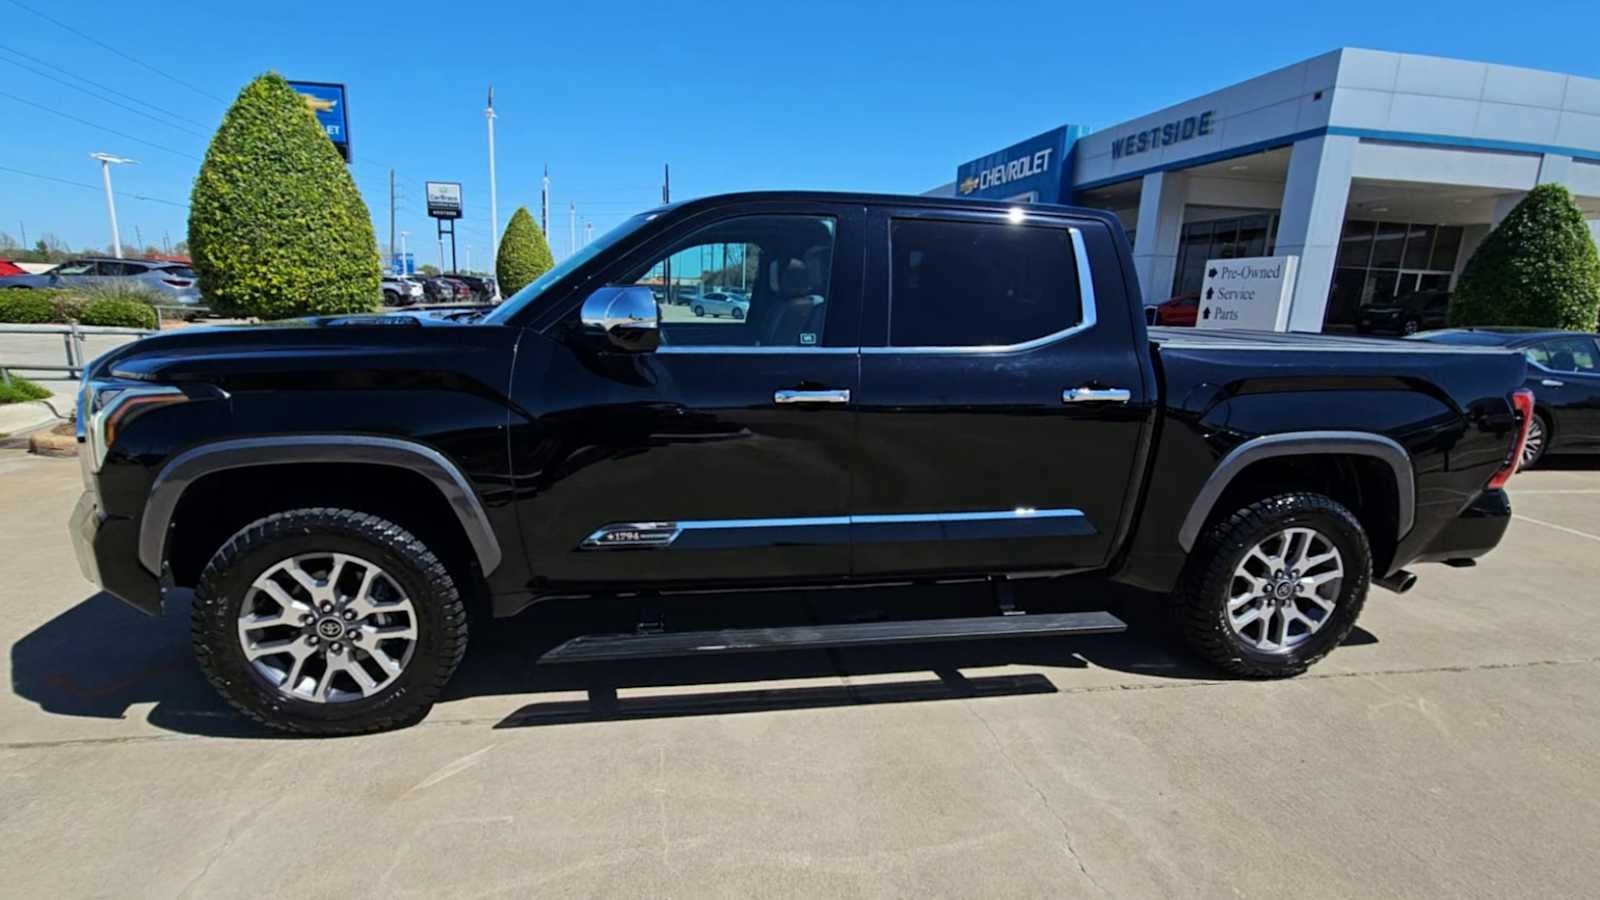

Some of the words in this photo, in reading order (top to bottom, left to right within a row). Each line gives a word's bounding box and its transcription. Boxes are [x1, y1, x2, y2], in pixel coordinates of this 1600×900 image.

[1111, 110, 1215, 160] WESTSIDE
[979, 148, 1053, 190] CHEVROLET
[1221, 265, 1281, 280] Pre-Owned
[1216, 287, 1255, 301] Service
[1214, 306, 1239, 321] Parts
[615, 531, 640, 541] 1794
